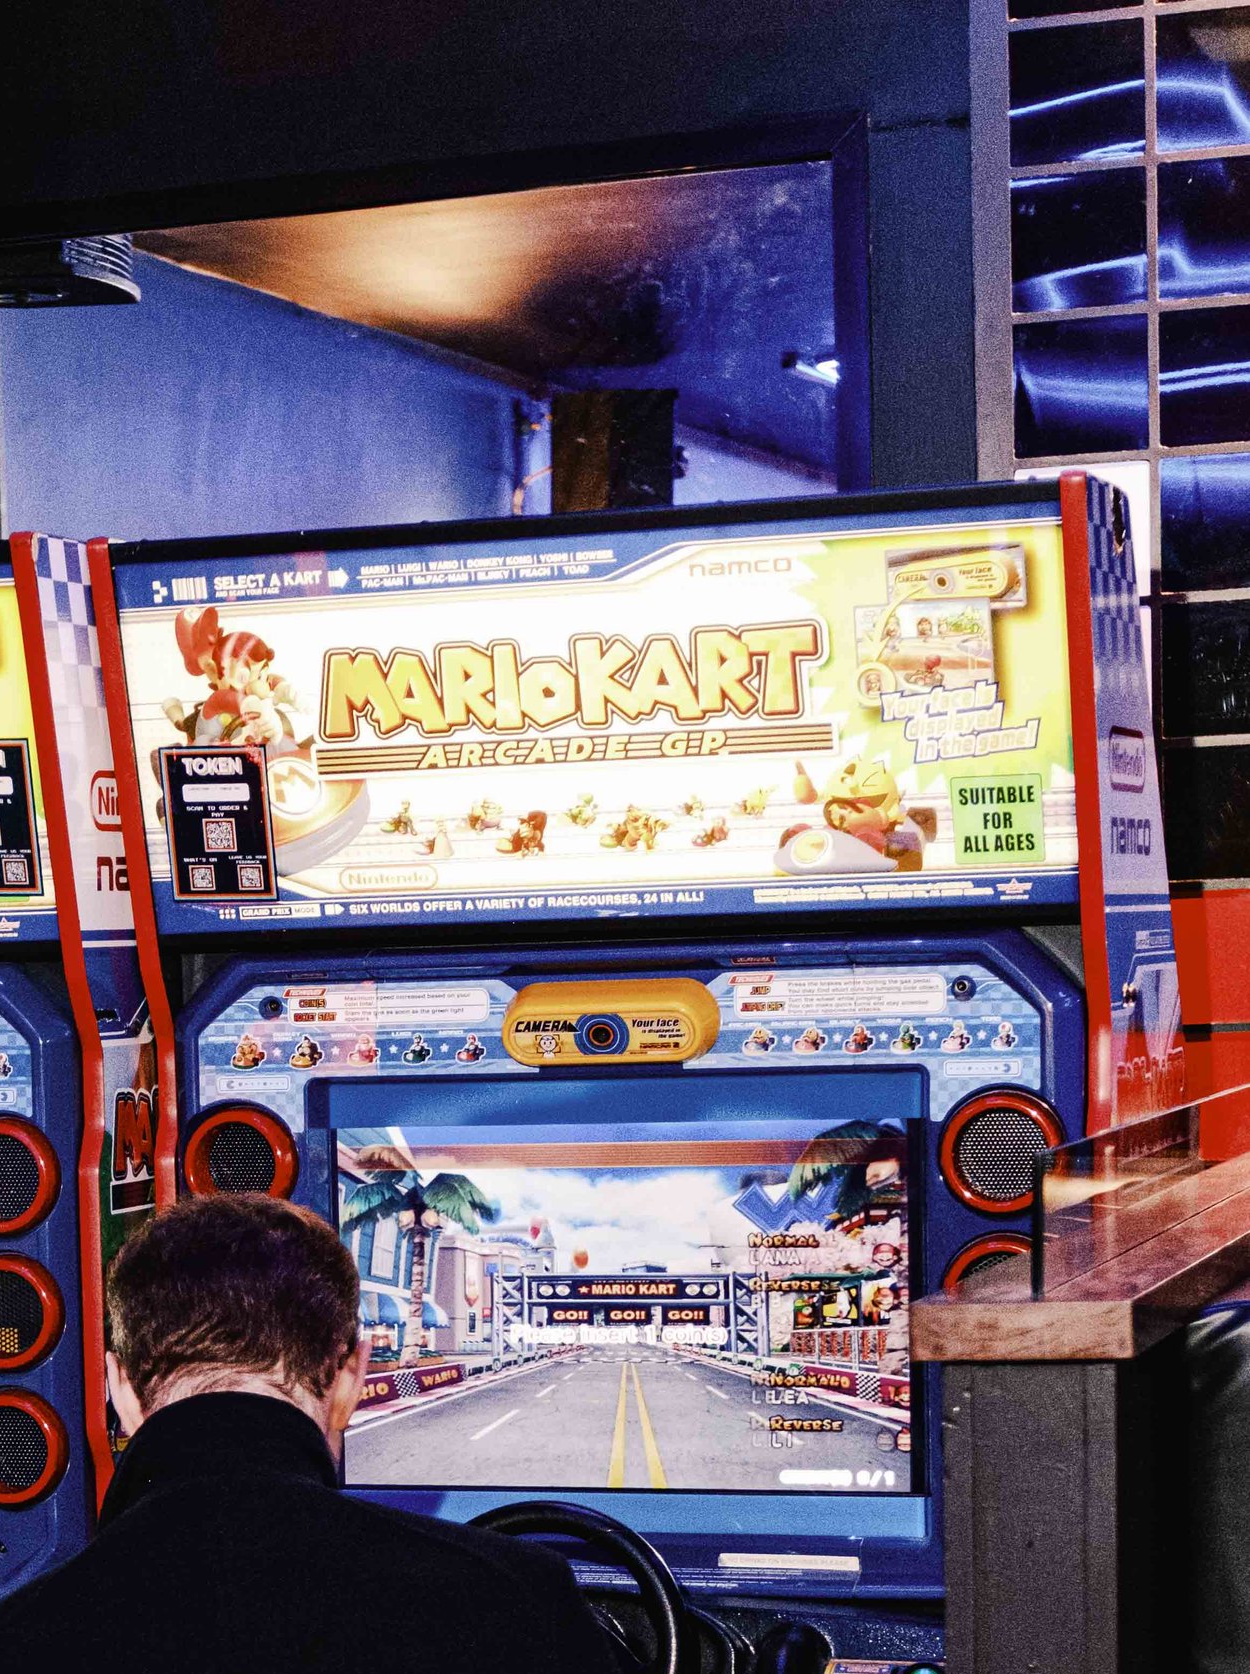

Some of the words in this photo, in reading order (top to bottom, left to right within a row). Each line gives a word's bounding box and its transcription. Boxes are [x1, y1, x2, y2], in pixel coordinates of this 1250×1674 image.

[361, 565, 390, 575] MARIO
[397, 563, 421, 573] LUIGI
[428, 560, 459, 571] WARIO
[539, 553, 568, 564] YOSHI
[689, 557, 792, 577] namco
[214, 573, 265, 589] SELECT
[269, 573, 281, 588] A
[283, 570, 322, 586] KART
[361, 577, 404, 588] PAC-MAN
[563, 564, 589, 575] TOAD
[418, 736, 628, 769] ARCADE
[181, 757, 243, 776] TOKEN
[959, 786, 1035, 805] SUITABLE
[983, 811, 1012, 830] FOR
[964, 834, 991, 853] ALL
[994, 833, 1035, 852] AGES
[1110, 817, 1151, 856] namco
[347, 871, 430, 885] Nintendo
[350, 904, 368, 915] SIX
[371, 903, 421, 914] WORLDS
[423, 901, 463, 912] OFFER
[465, 900, 474, 910] A
[475, 897, 526, 910] VARIETY
[528, 896, 545, 908] OF
[547, 893, 642, 908] RACECOURSES,
[644, 892, 658, 904] 24
[660, 892, 674, 903] IN
[676, 891, 704, 902] ALL!
[750, 986, 771, 995] JUMP
[515, 1020, 568, 1033] CAMERA
[631, 1018, 654, 1028] Your
[656, 1017, 679, 1028] face
[592, 1283, 635, 1296] MARIO
[639, 1283, 677, 1295] KART
[553, 1310, 588, 1321] GO!!
[610, 1310, 646, 1321] GO!!
[668, 1310, 704, 1321] GO!!
[509, 1324, 576, 1345] Please
[580, 1324, 638, 1345] insert
[643, 1324, 657, 1346] 1
[661, 1325, 729, 1346] coin(s)
[421, 1369, 459, 1388] WARIO
[769, 1414, 844, 1432] REVERSE
